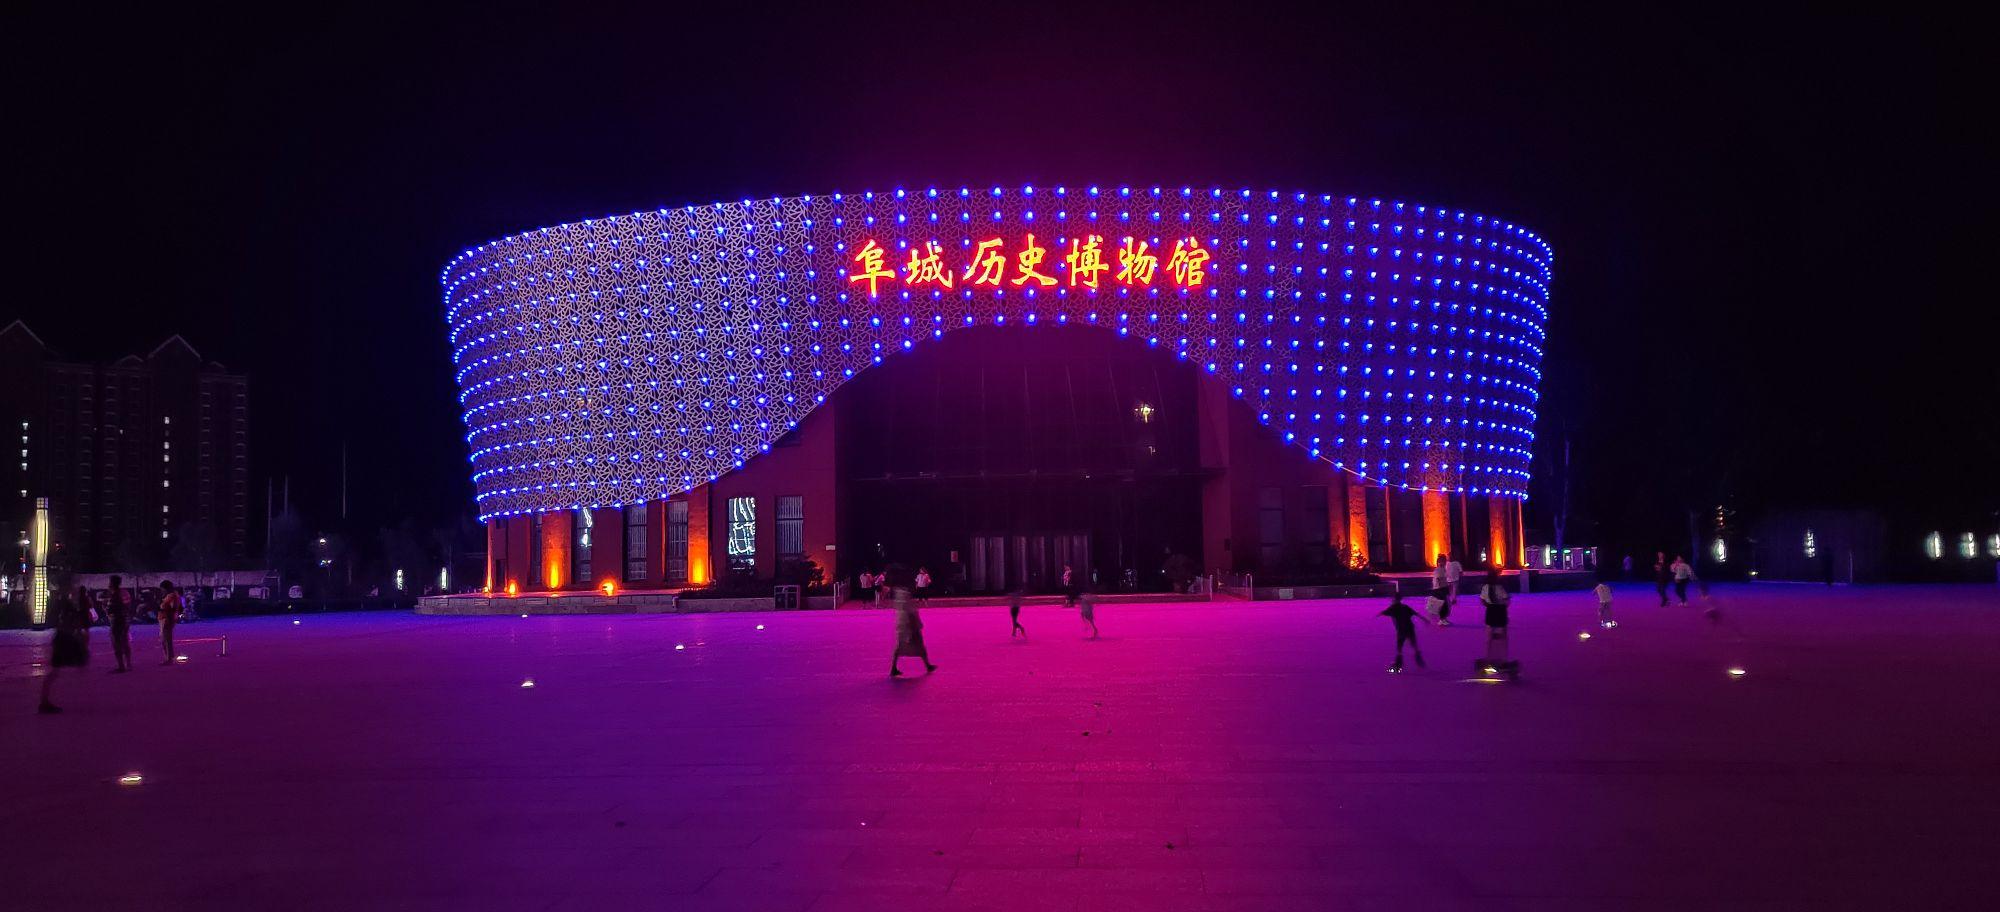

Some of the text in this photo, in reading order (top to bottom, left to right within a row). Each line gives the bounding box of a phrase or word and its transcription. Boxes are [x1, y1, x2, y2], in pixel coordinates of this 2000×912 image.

[849, 233, 1210, 297] 阜城历史博物馆
